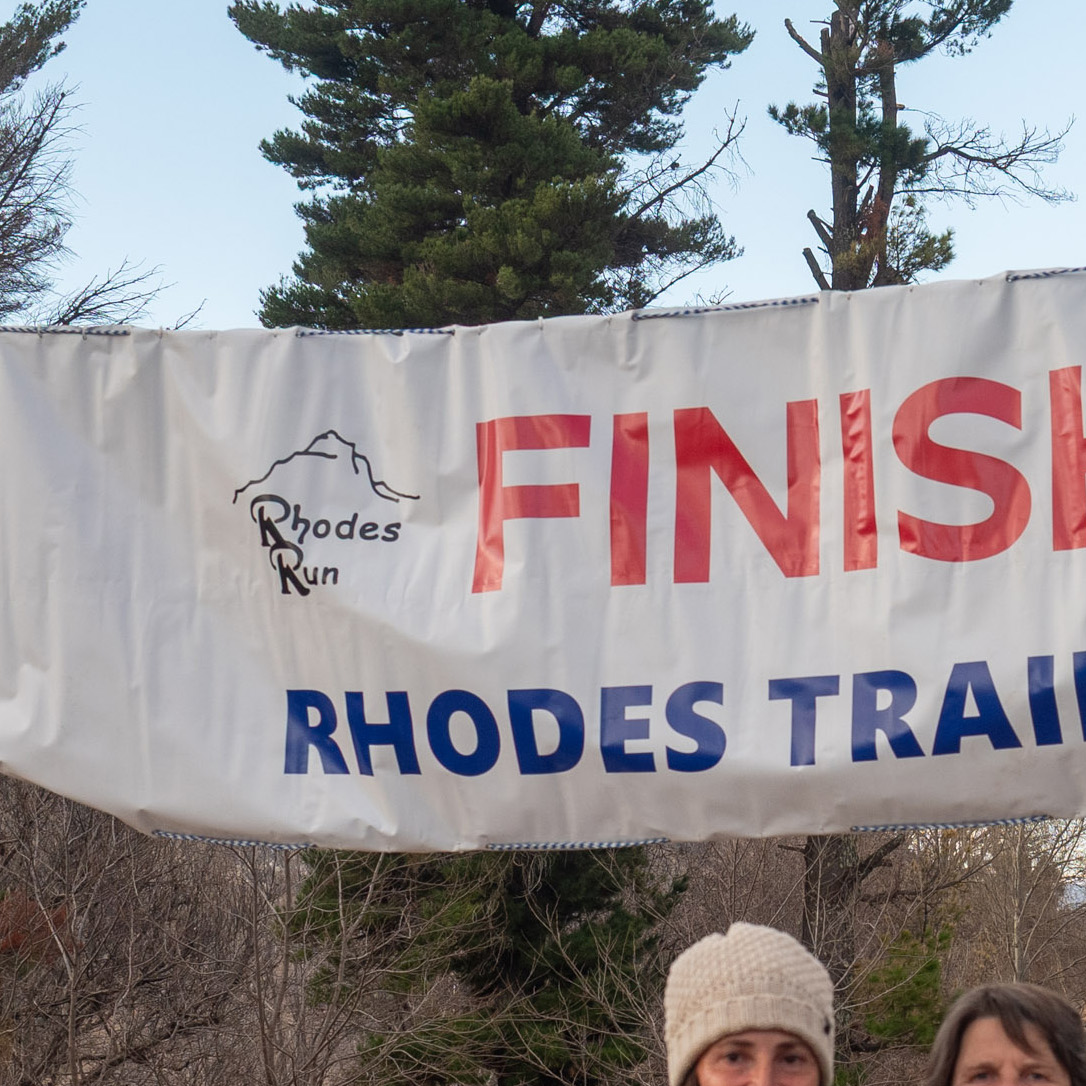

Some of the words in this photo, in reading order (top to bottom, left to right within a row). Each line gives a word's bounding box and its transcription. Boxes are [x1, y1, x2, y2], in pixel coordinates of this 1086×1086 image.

[250, 493, 402, 548] Rhodes
[269, 540, 339, 596] Run
[283, 681, 727, 777] RHODES
